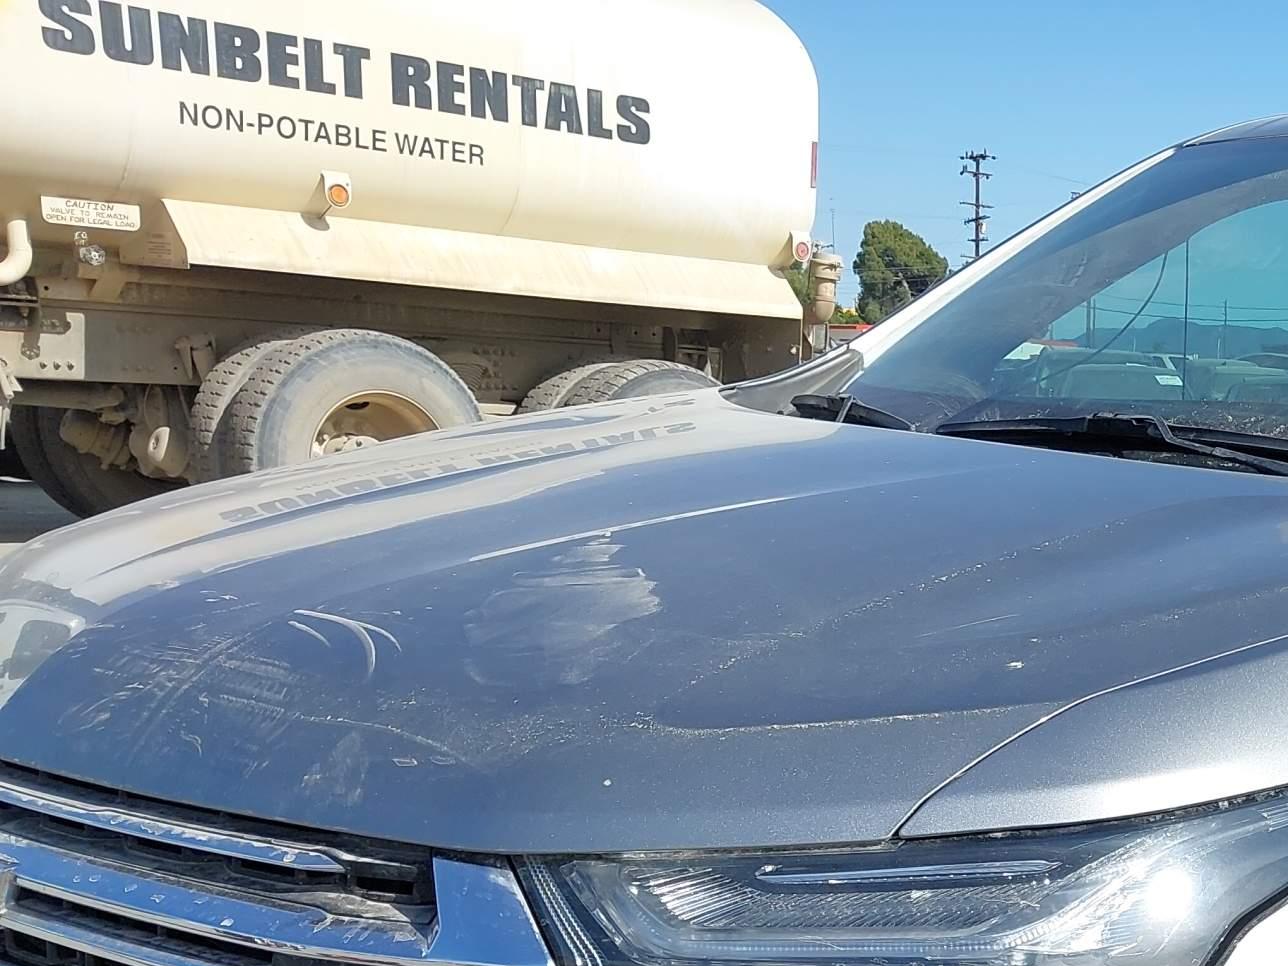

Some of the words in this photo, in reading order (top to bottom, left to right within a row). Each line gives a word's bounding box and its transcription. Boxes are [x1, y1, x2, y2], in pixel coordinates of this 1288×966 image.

[38, 0, 371, 100] SUNBELT
[390, 52, 651, 145] RENTALS
[178, 100, 387, 152] NON-POTABLE
[395, 132, 485, 166] WATER
[65, 199, 115, 212] CAUTION
